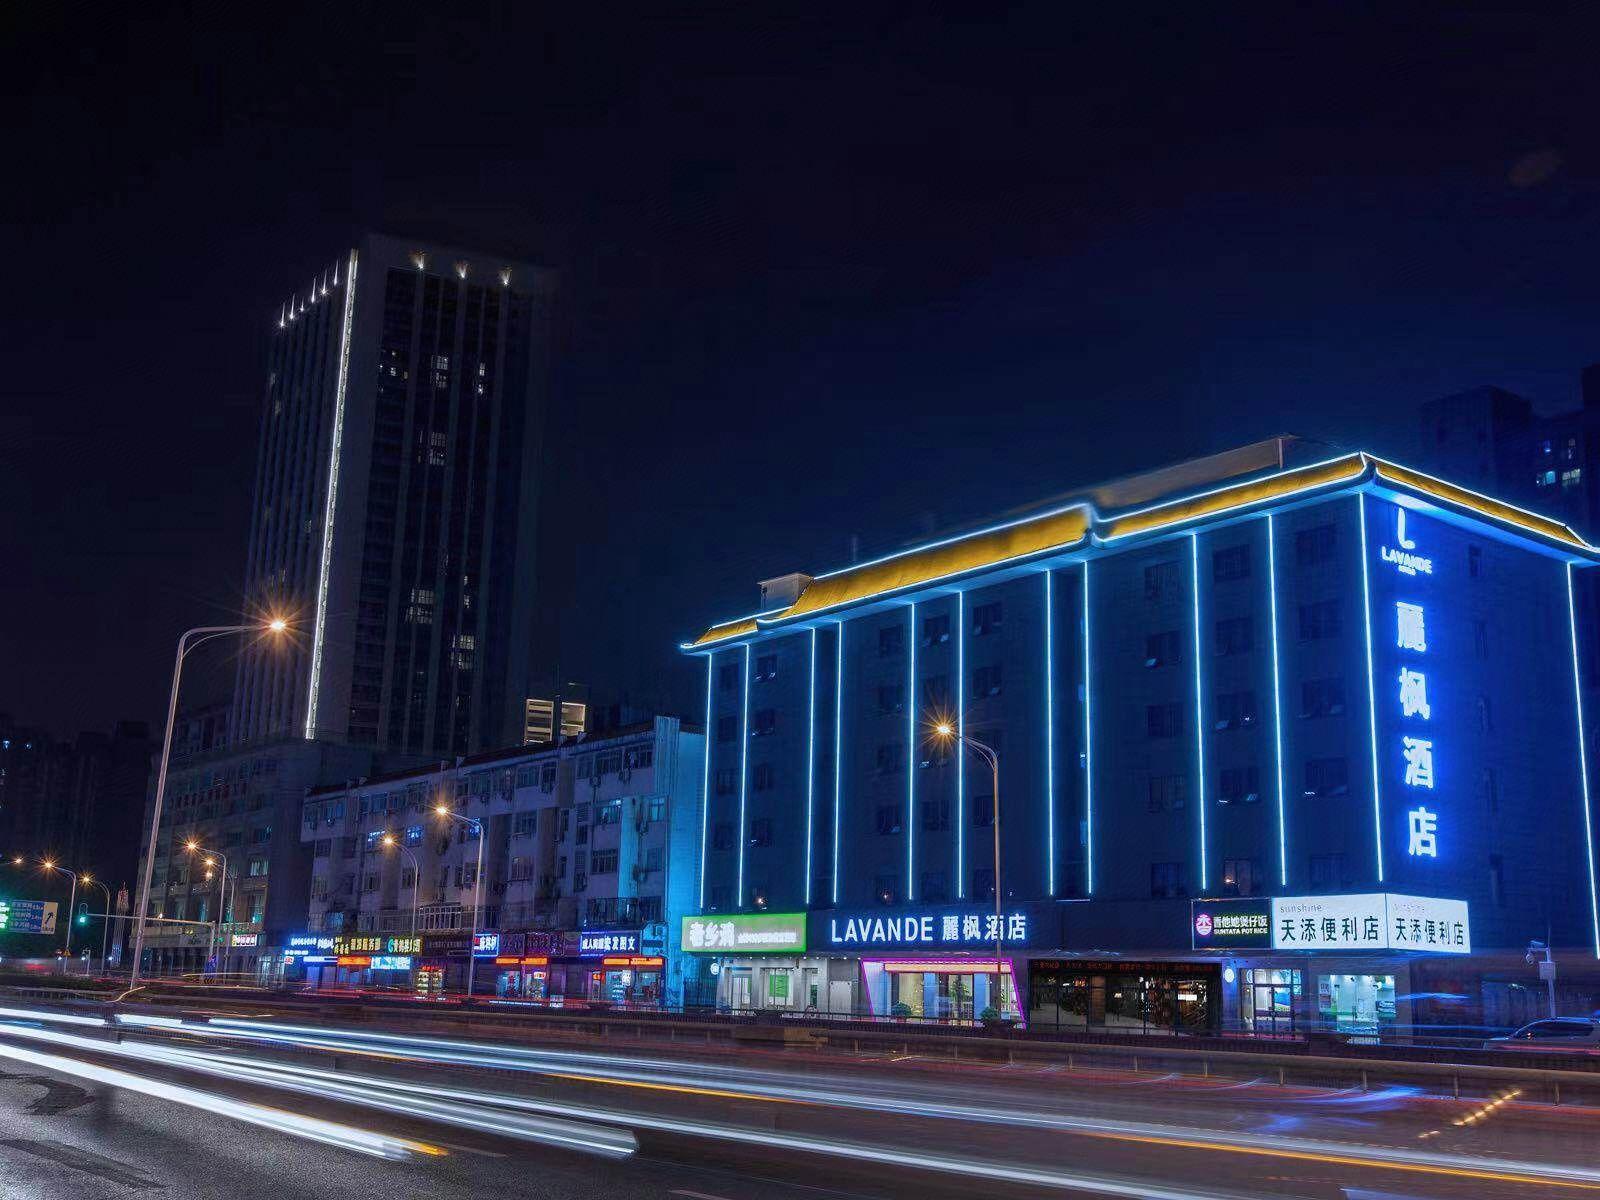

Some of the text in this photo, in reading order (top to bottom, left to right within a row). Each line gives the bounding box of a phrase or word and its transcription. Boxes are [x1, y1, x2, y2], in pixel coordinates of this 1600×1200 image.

[1381, 546, 1432, 575] LAVANDE
[831, 917, 934, 942] LAVANDE
[1281, 916, 1379, 942] 天添便利店
[1395, 917, 1464, 946] 天添便利店
